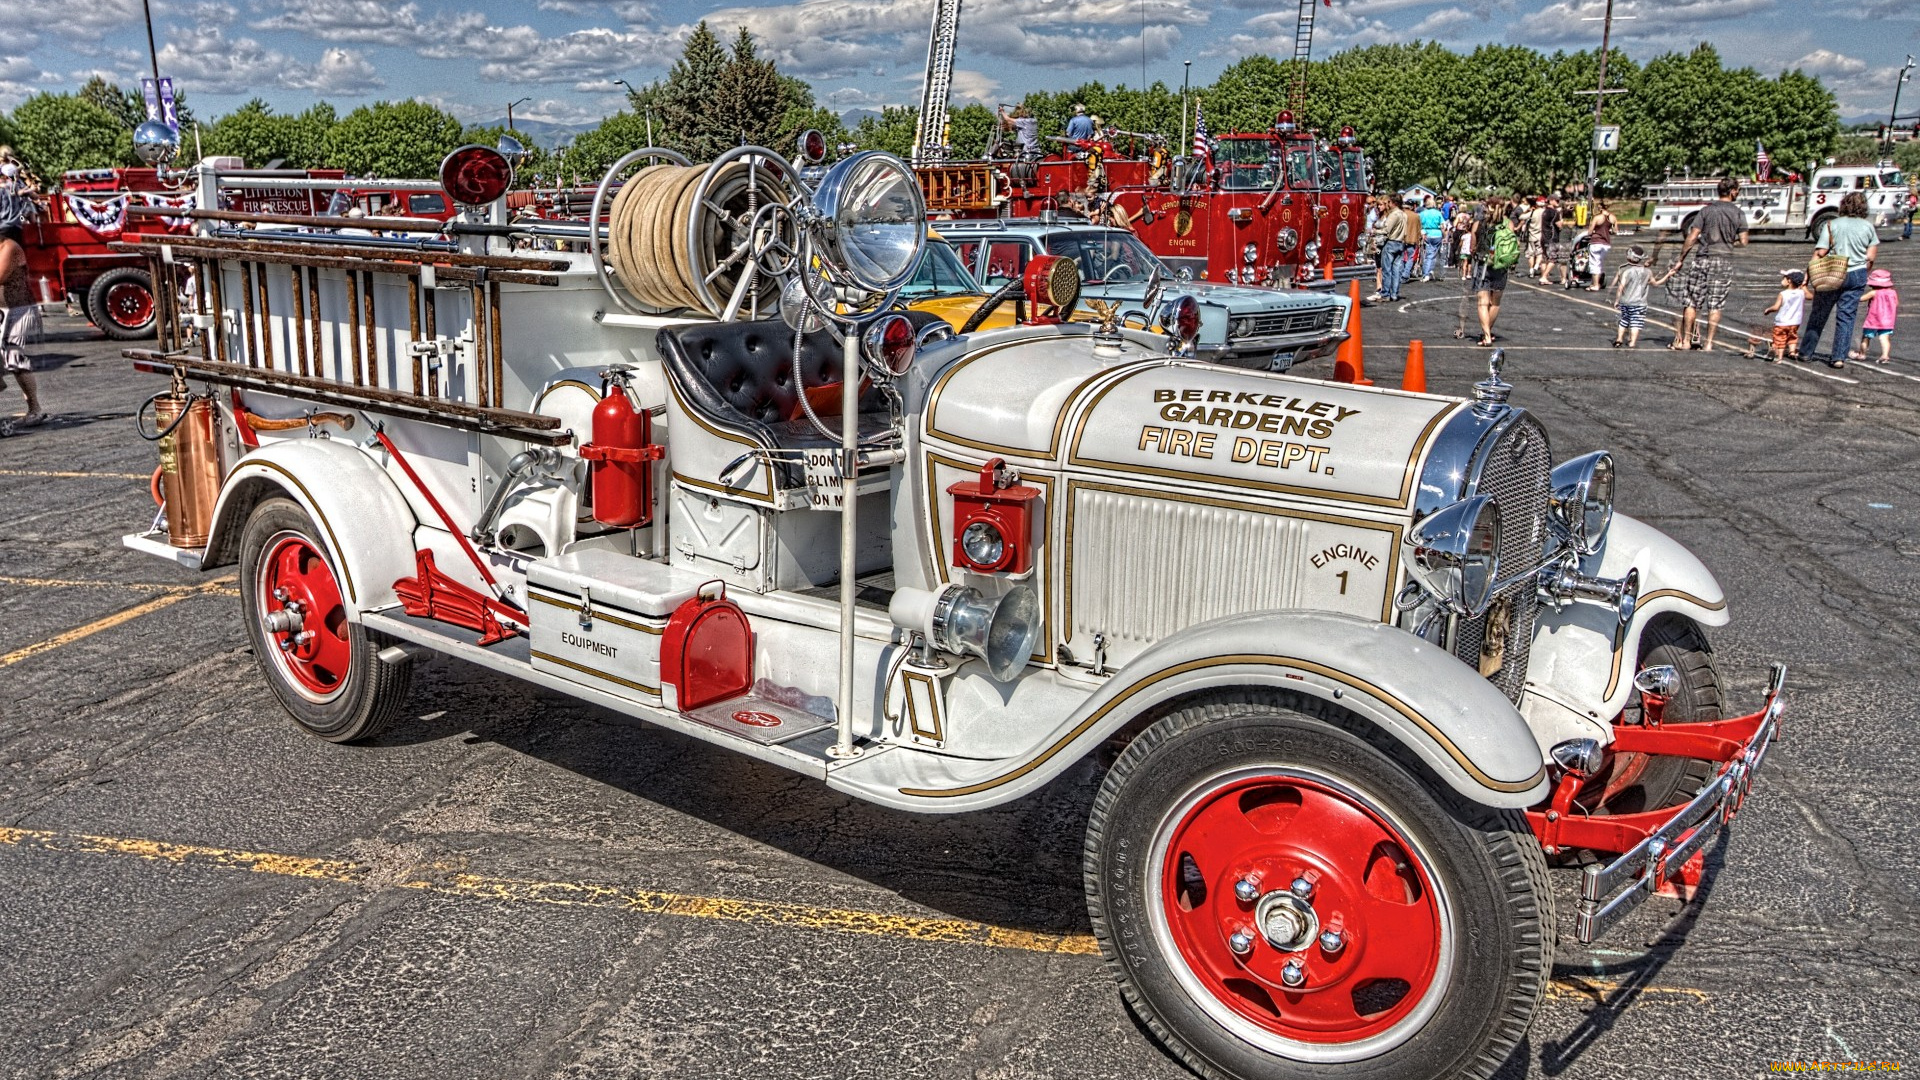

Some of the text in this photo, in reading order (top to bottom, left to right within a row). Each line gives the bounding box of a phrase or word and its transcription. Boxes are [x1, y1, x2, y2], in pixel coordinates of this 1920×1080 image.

[244, 188, 304, 199] LITTLETON
[1816, 193, 1827, 205] 3
[269, 200, 309, 212] RESCUE
[1168, 239, 1197, 247] ENGINE
[1154, 389, 1362, 423] BERKELEY
[1160, 402, 1335, 439] GARDENS
[1138, 425, 1335, 476] FIRE DEPT.
[807, 474, 843, 488] CLIM
[813, 494, 830, 506] ON
[1310, 543, 1380, 571] ENGINE
[1335, 570, 1349, 595] 1
[561, 631, 618, 659] EQUIPMENT
